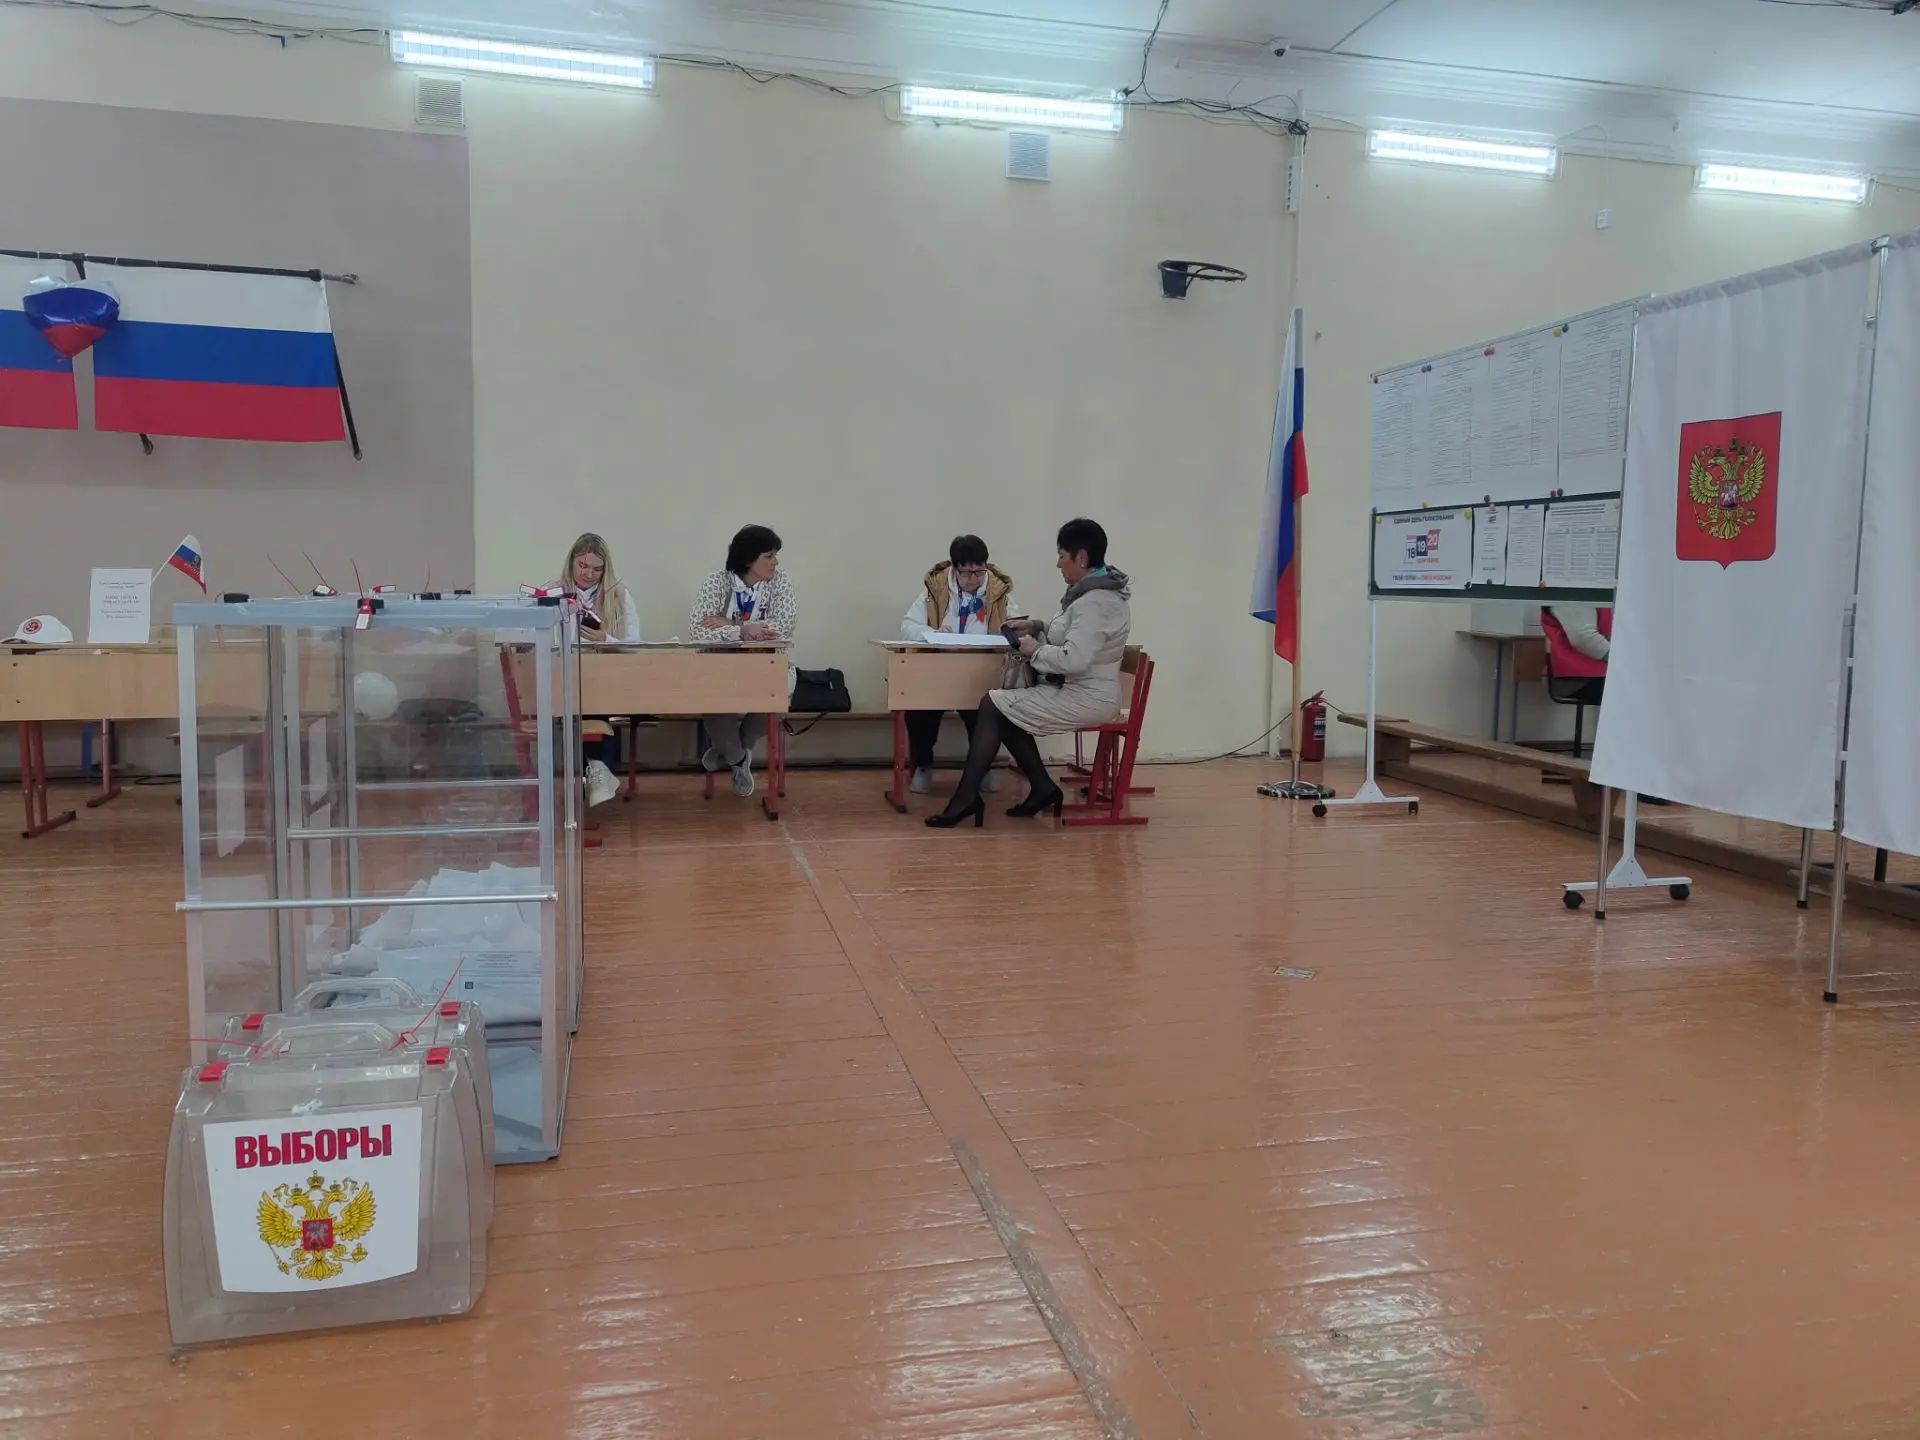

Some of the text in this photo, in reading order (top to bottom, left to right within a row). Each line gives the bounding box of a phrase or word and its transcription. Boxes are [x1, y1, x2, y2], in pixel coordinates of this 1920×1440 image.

[1408, 534, 1438, 559] 18 19 20
[235, 1124, 392, 1169] ВЫБОРЫ
